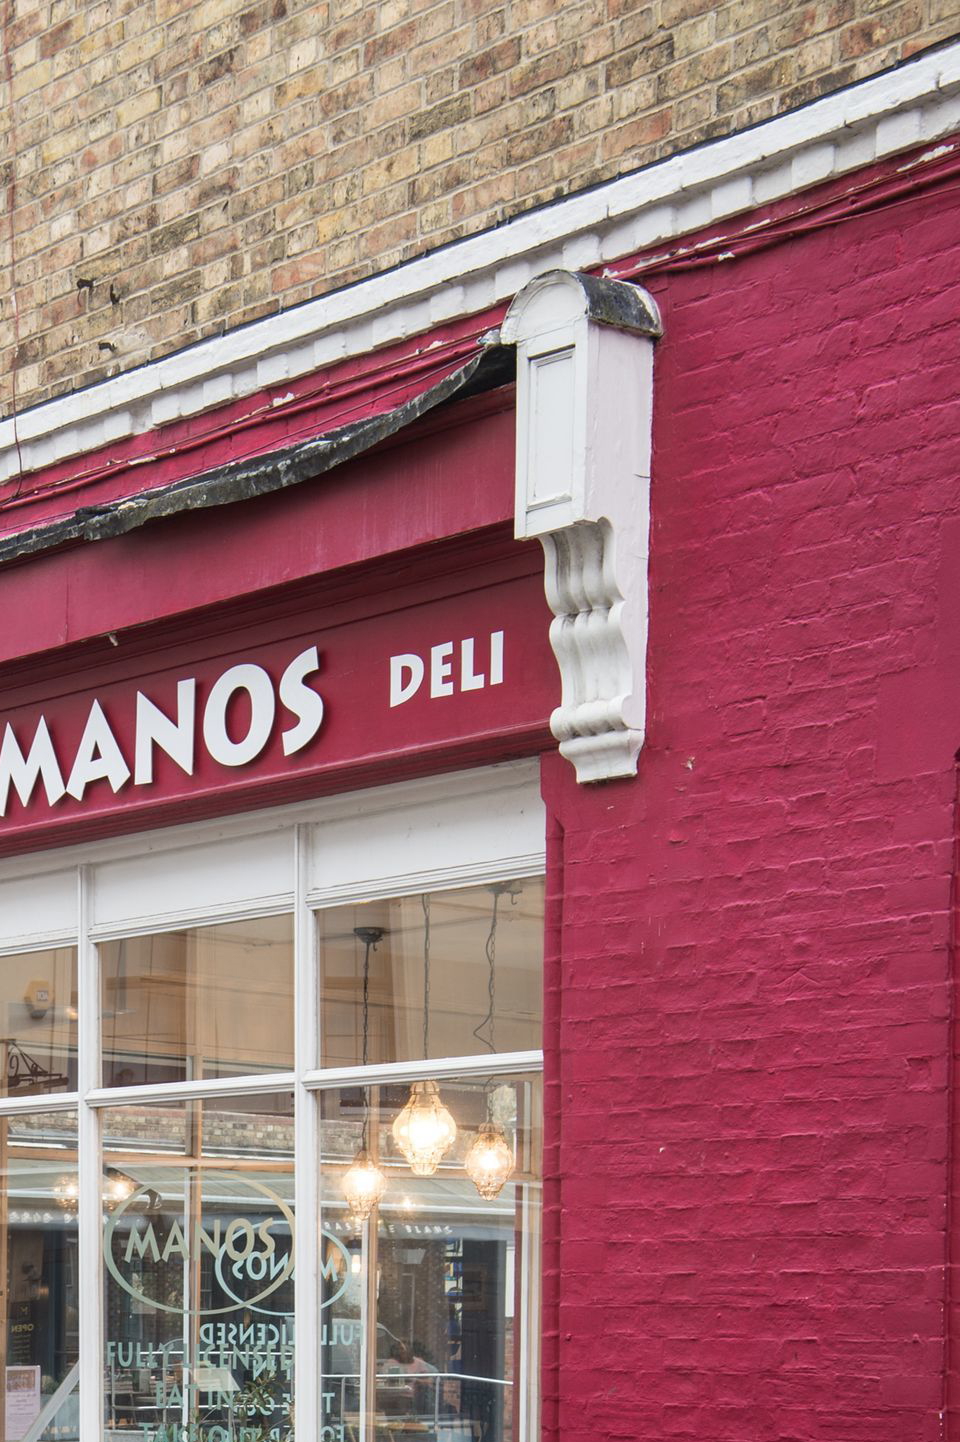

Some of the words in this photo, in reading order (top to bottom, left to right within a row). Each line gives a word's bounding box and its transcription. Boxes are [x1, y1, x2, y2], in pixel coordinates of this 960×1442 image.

[389, 630, 504, 708] DELI
[124, 1217, 276, 1264] MANOS
[106, 1341, 175, 1368] FULLY
[156, 1380, 199, 1408] EAT
[207, 1384, 235, 1410] IN
